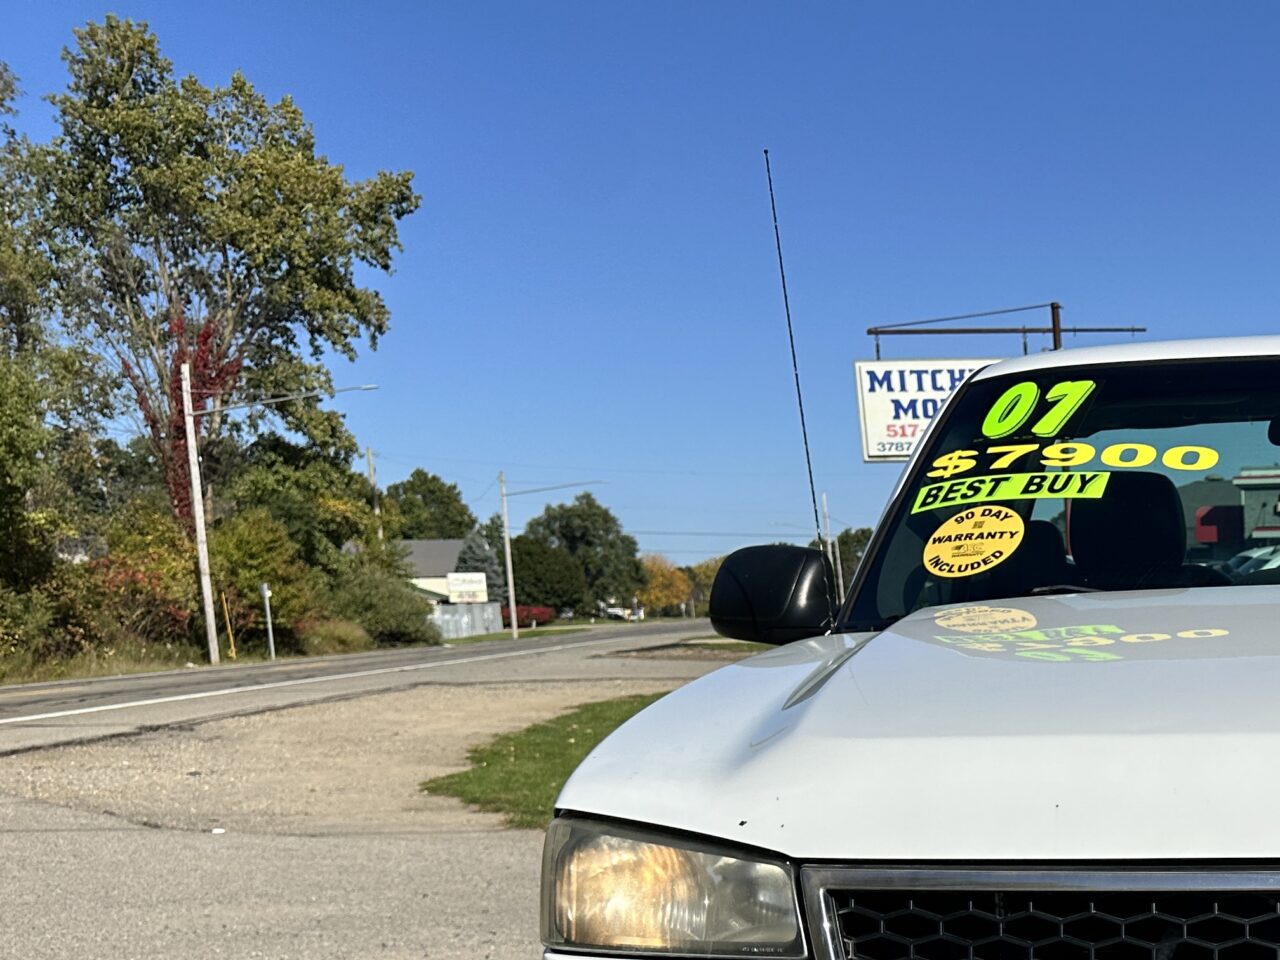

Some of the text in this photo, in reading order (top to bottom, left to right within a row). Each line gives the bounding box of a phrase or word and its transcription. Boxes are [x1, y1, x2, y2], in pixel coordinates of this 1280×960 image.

[866, 369, 976, 392] MITCH
[982, 381, 1096, 439] 07
[926, 443, 1219, 478] $7900
[918, 474, 1101, 509] BEST BUY
[954, 508, 1013, 524] 90 DAY
[932, 531, 1019, 544] WARRANTY
[928, 550, 1003, 573] INCLUDED
